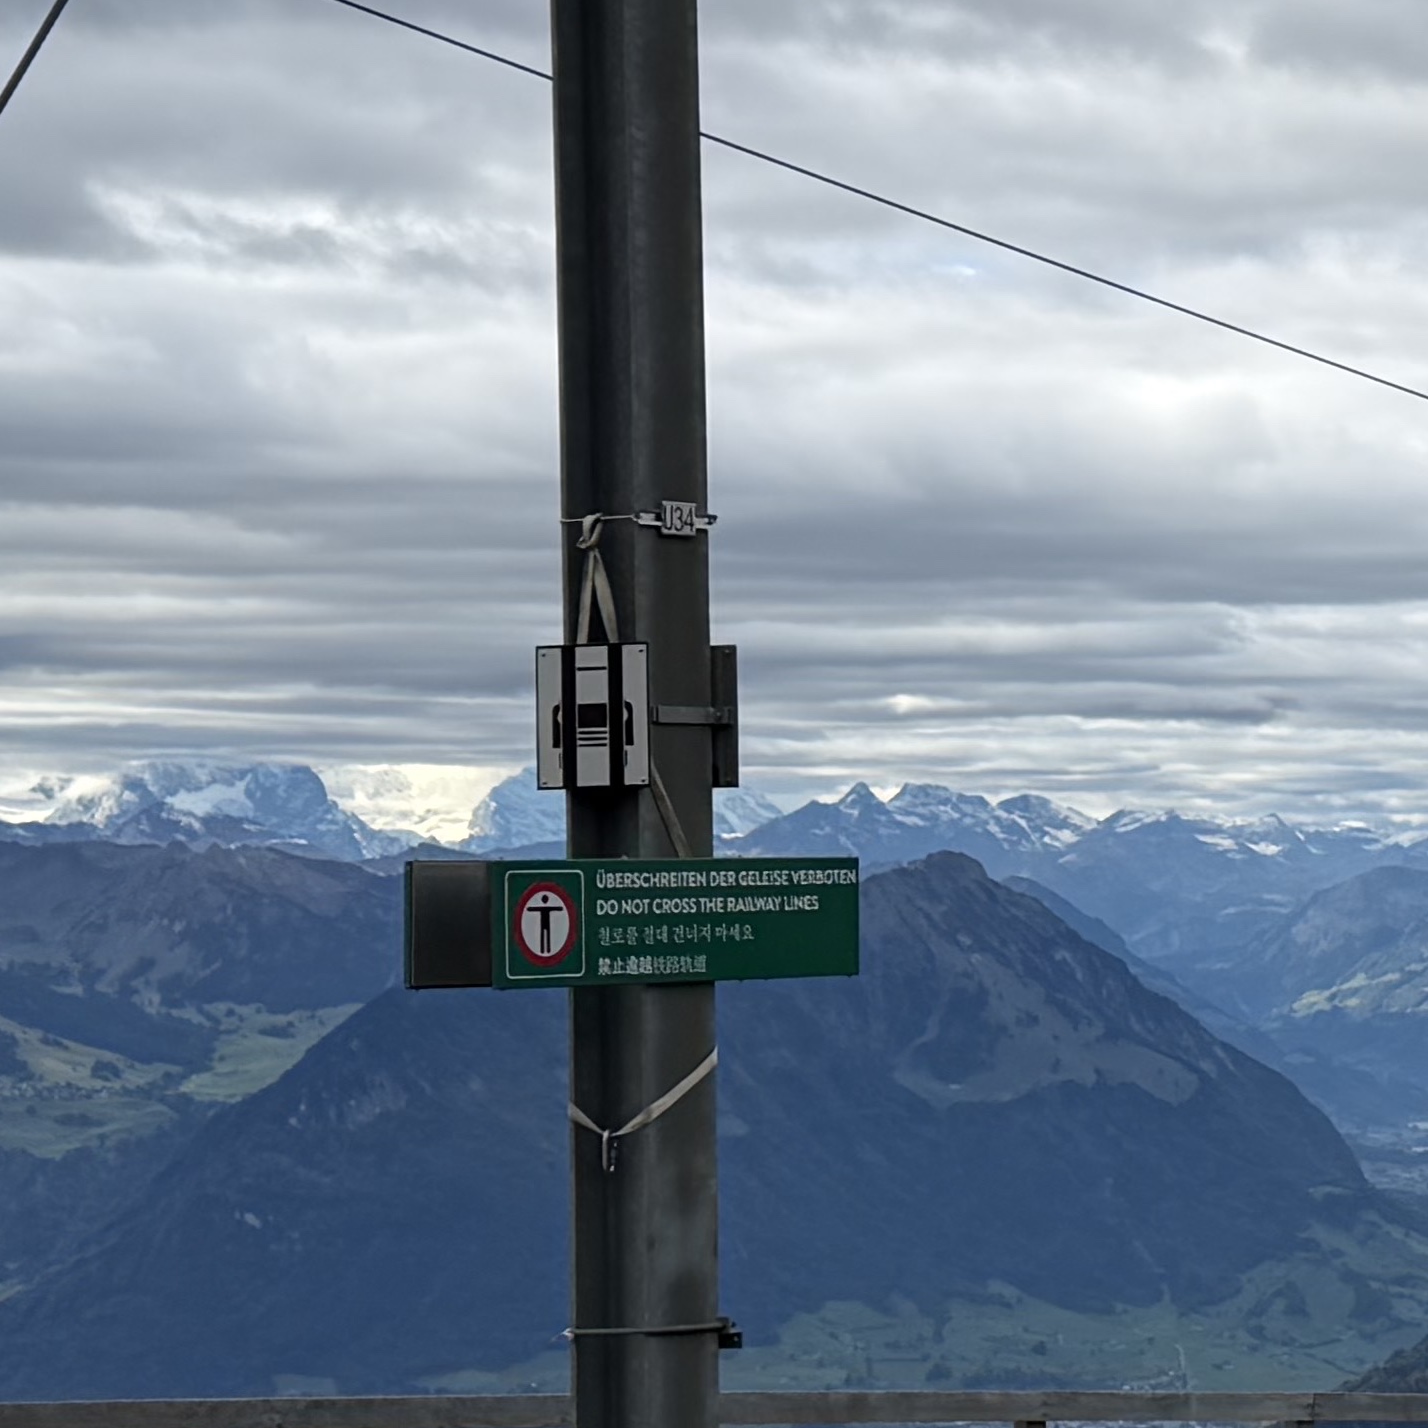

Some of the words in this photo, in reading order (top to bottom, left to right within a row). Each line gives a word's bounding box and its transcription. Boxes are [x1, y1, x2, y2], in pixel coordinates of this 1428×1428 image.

[596, 869, 707, 888] ÜBERSCHREITEN
[709, 871, 736, 887] DER
[738, 870, 789, 887] GELEISE
[791, 869, 857, 885] VERBOTEN
[596, 899, 619, 915] DO
[621, 898, 651, 914] NOT
[652, 898, 697, 914] CROSS
[698, 897, 725, 913] THE
[727, 896, 782, 912] RAILWAY
[784, 895, 819, 910] LINES
